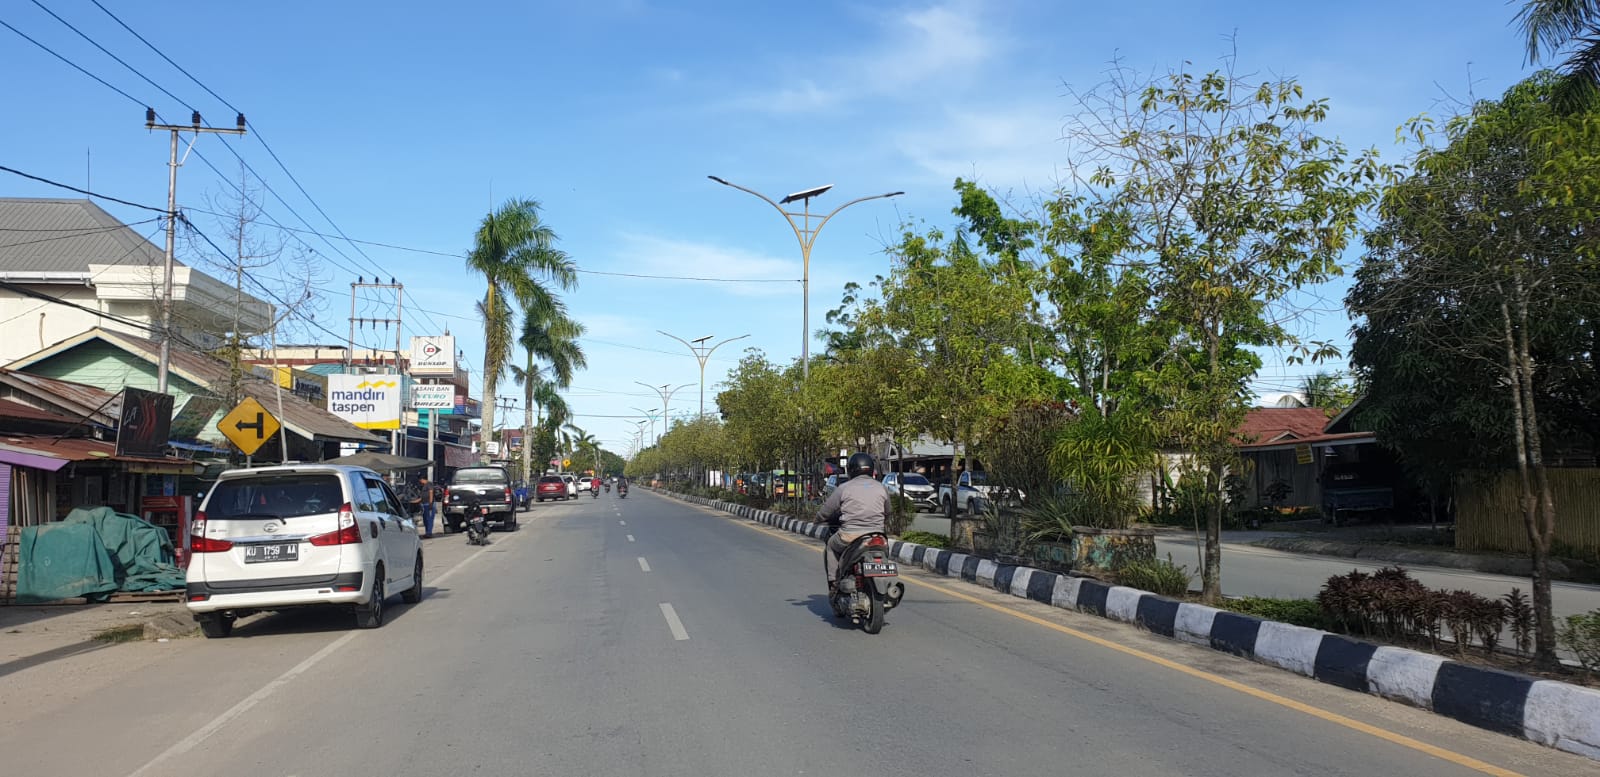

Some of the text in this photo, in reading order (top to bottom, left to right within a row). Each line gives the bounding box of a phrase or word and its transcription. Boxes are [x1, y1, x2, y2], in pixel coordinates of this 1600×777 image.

[331, 388, 385, 401] mandiri
[332, 402, 375, 415] taspen
[246, 546, 256, 556] KU
[287, 545, 296, 554] AA
